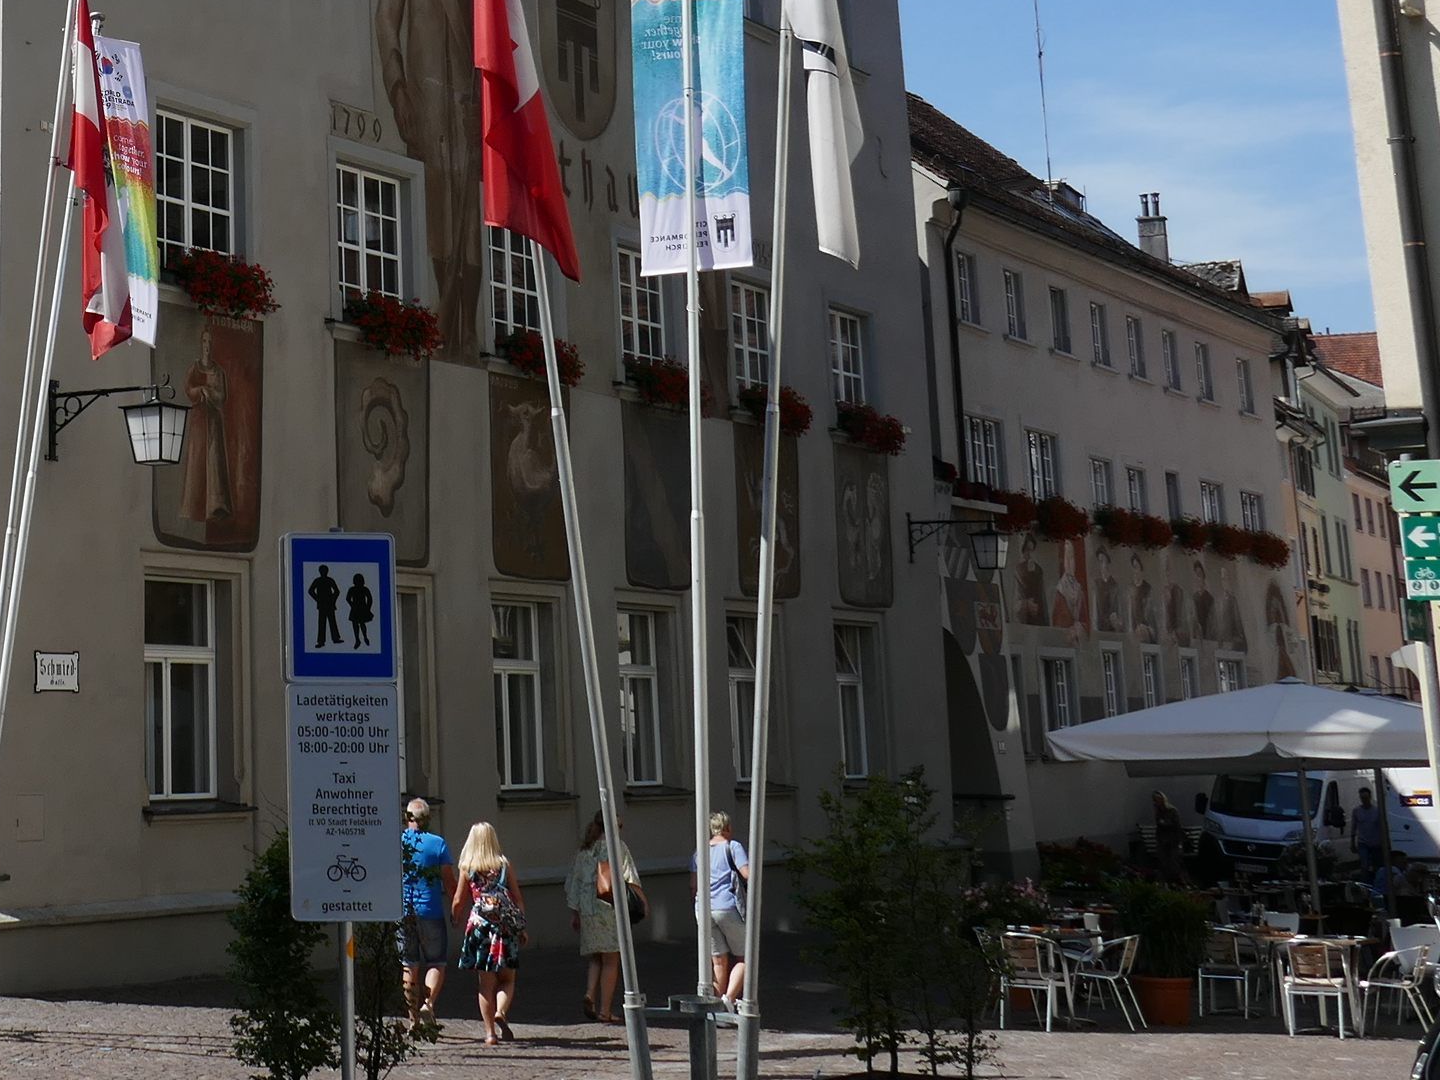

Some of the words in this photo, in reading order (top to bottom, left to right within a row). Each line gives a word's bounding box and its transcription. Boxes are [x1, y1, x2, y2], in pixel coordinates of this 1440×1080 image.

[330, 103, 383, 143] 1799
[296, 694, 389, 708] Ladetätigkeiten
[315, 711, 370, 723] werktags
[297, 726, 364, 738] 05:00-10:00
[368, 726, 389, 738] Uhr
[298, 742, 365, 754] 18:00-20:00
[368, 742, 390, 754] Uhr
[332, 773, 356, 784] Taxi
[315, 788, 375, 800] Anwohner
[312, 803, 379, 818] Berechtigte
[328, 818, 348, 826] Stadt
[349, 818, 382, 826] Feldkirch
[321, 900, 373, 913] gestattet
